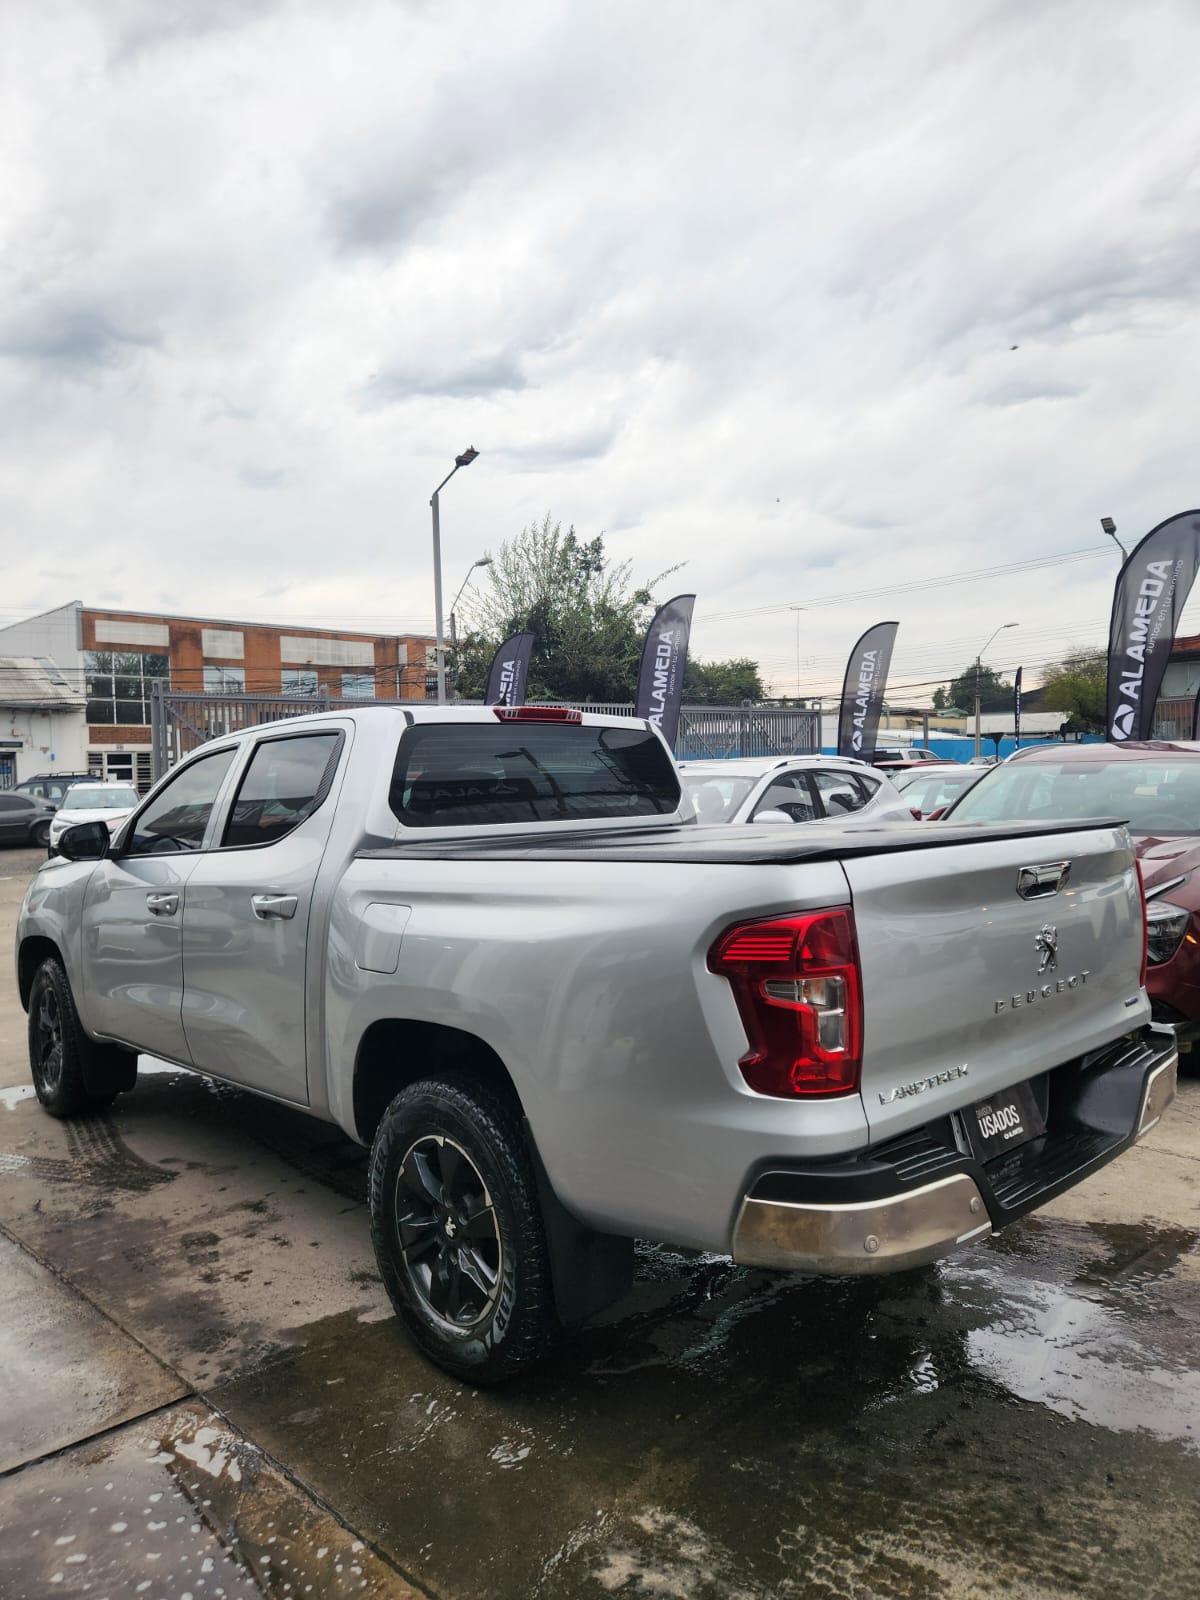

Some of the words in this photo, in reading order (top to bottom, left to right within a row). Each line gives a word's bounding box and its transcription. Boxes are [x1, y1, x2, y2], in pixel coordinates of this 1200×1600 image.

[1167, 560, 1184, 596] camino
[1158, 609, 1167, 621] en
[1161, 597, 1171, 608] tu
[1119, 560, 1173, 699] ALAMEDA
[1145, 622, 1161, 654] Juntos
[648, 630, 674, 727] ALAMEDA
[853, 650, 878, 728] ALAMEDA
[994, 970, 1090, 1014] PEUGEOT
[878, 1063, 969, 1106] LANDTREK
[978, 1104, 1020, 1139] USADOS
